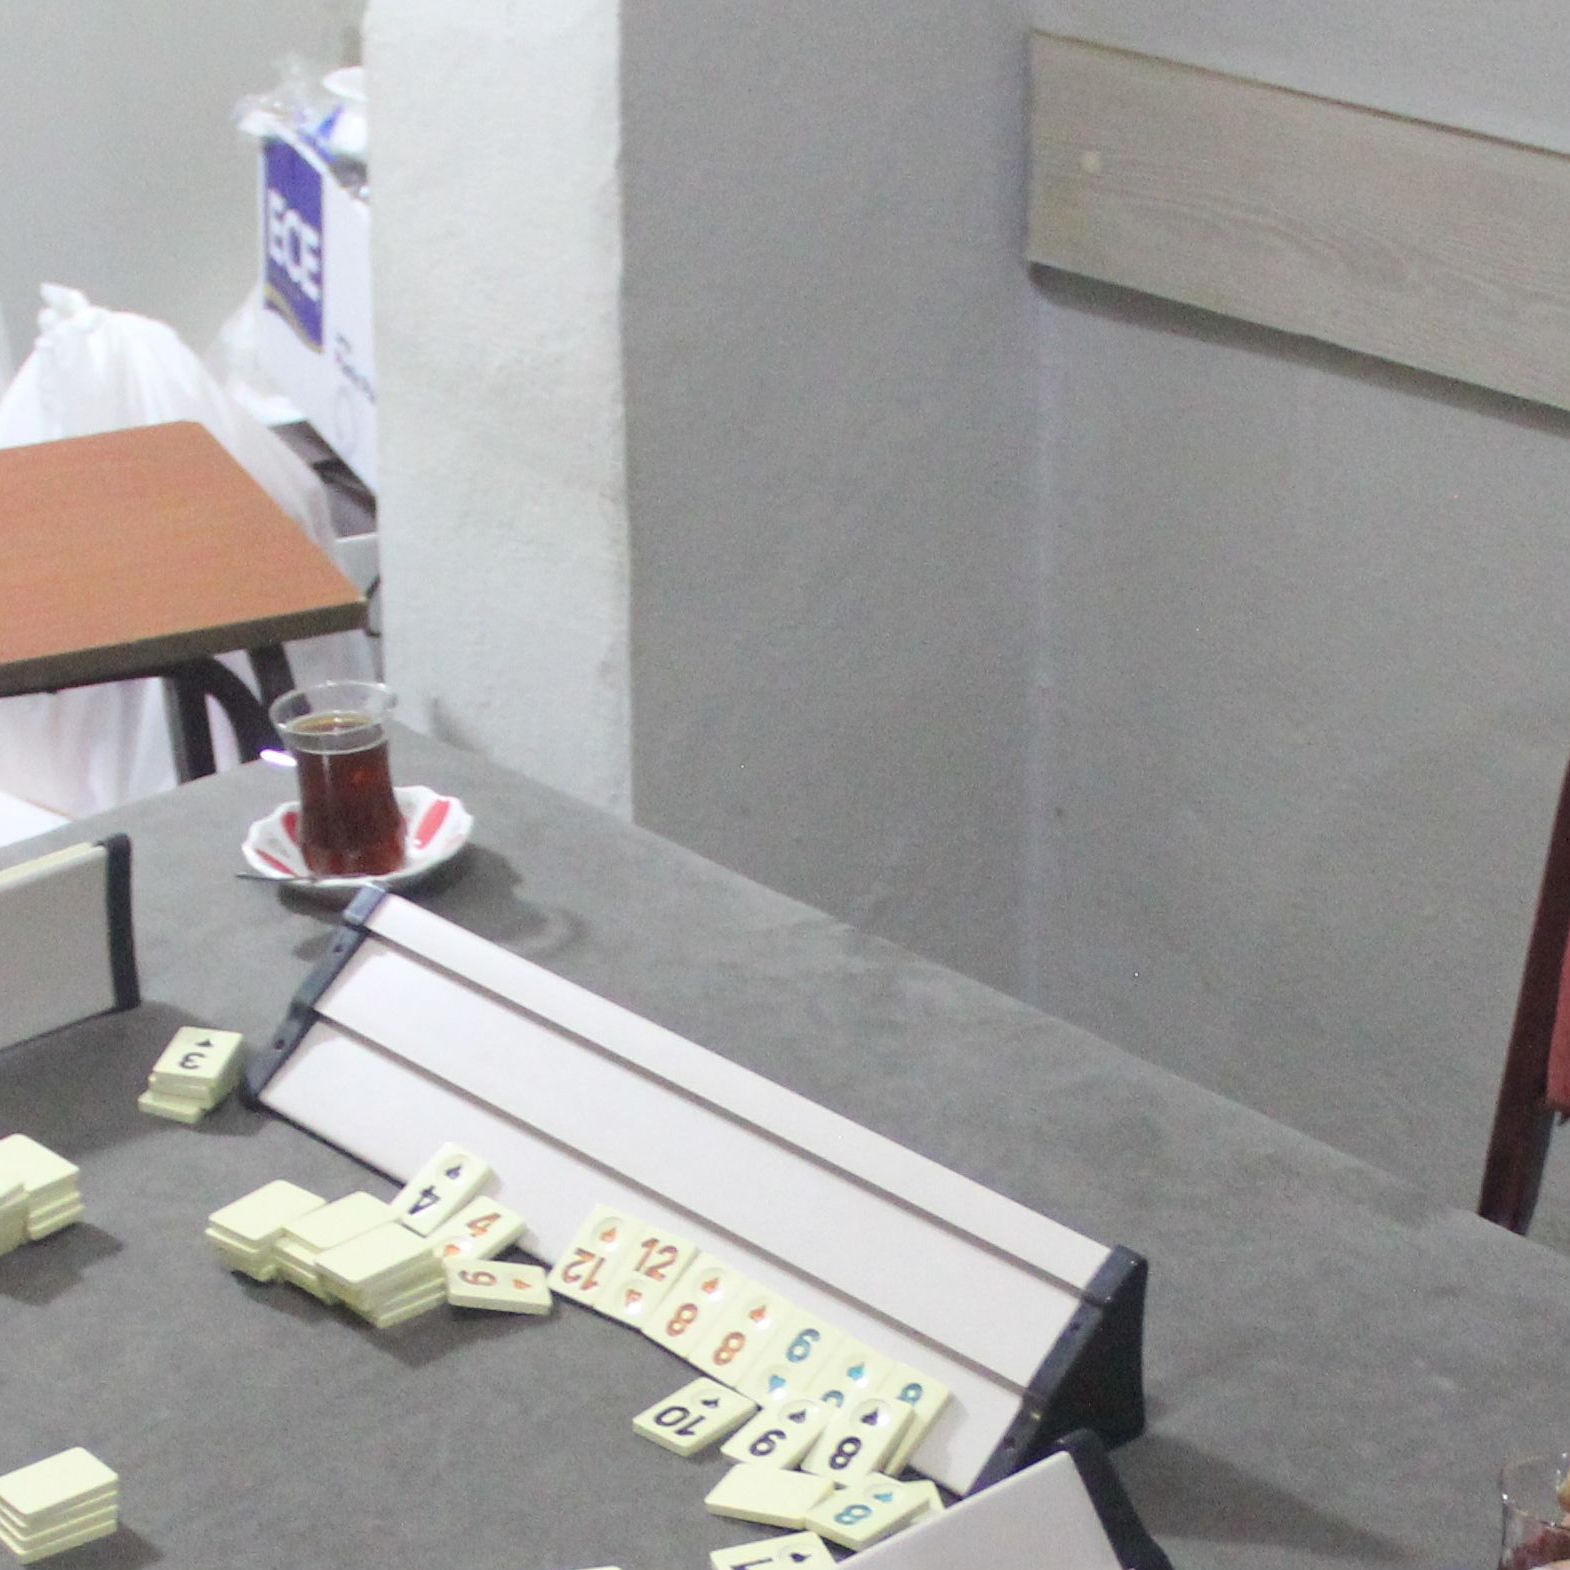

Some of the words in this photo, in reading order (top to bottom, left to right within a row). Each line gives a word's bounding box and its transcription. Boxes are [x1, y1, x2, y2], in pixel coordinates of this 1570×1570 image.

[268, 188, 322, 302] ECE
[632, 1237, 679, 1282] 12
[666, 1303, 699, 1337] 8
[712, 1331, 746, 1366] 8
[828, 1436, 862, 1470] 8
[833, 1504, 873, 1526] 8
